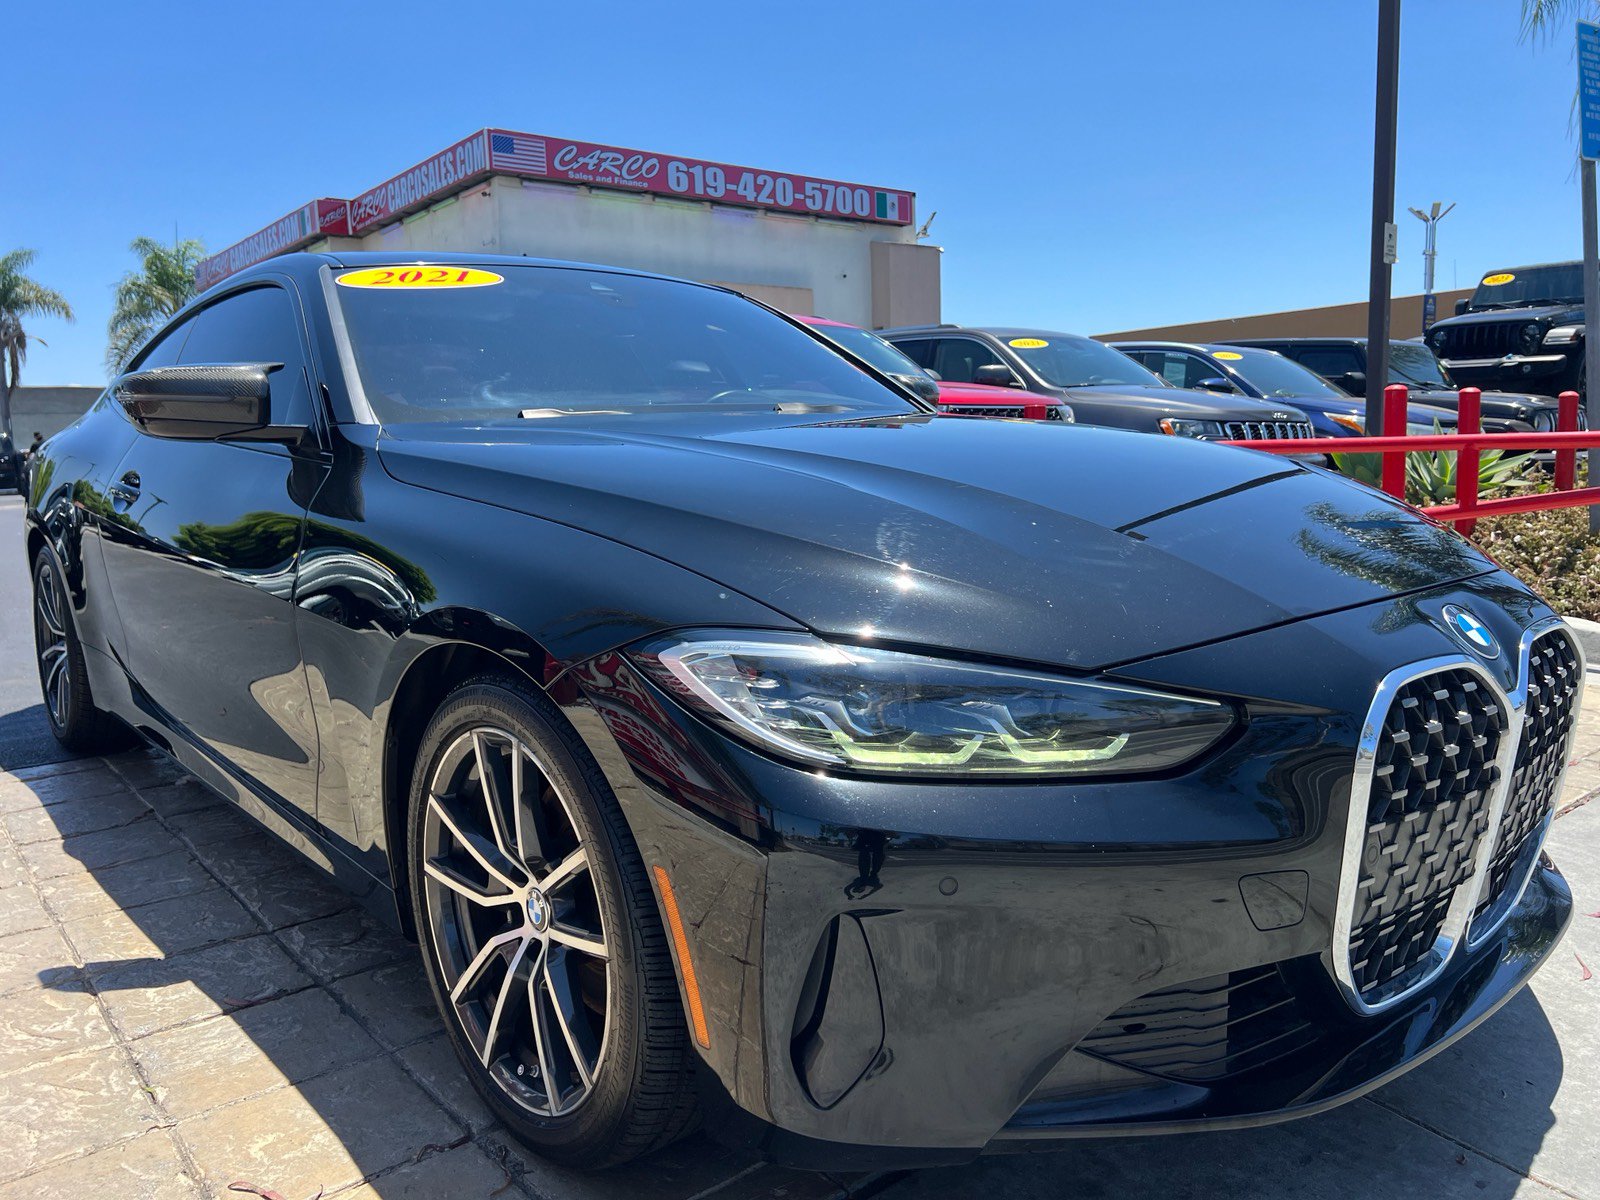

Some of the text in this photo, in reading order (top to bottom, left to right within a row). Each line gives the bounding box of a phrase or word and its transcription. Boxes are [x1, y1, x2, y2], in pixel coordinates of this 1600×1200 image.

[352, 134, 485, 227] CARCO CARCOSALES.COM
[553, 145, 660, 179] CARCO
[568, 171, 648, 187] Sales and Finance
[667, 160, 871, 217] 619-420-5700
[230, 213, 300, 272] CARCOSALES.COM
[371, 270, 471, 284] 2021
[620, 984, 634, 1073] BRIDGESTONE
